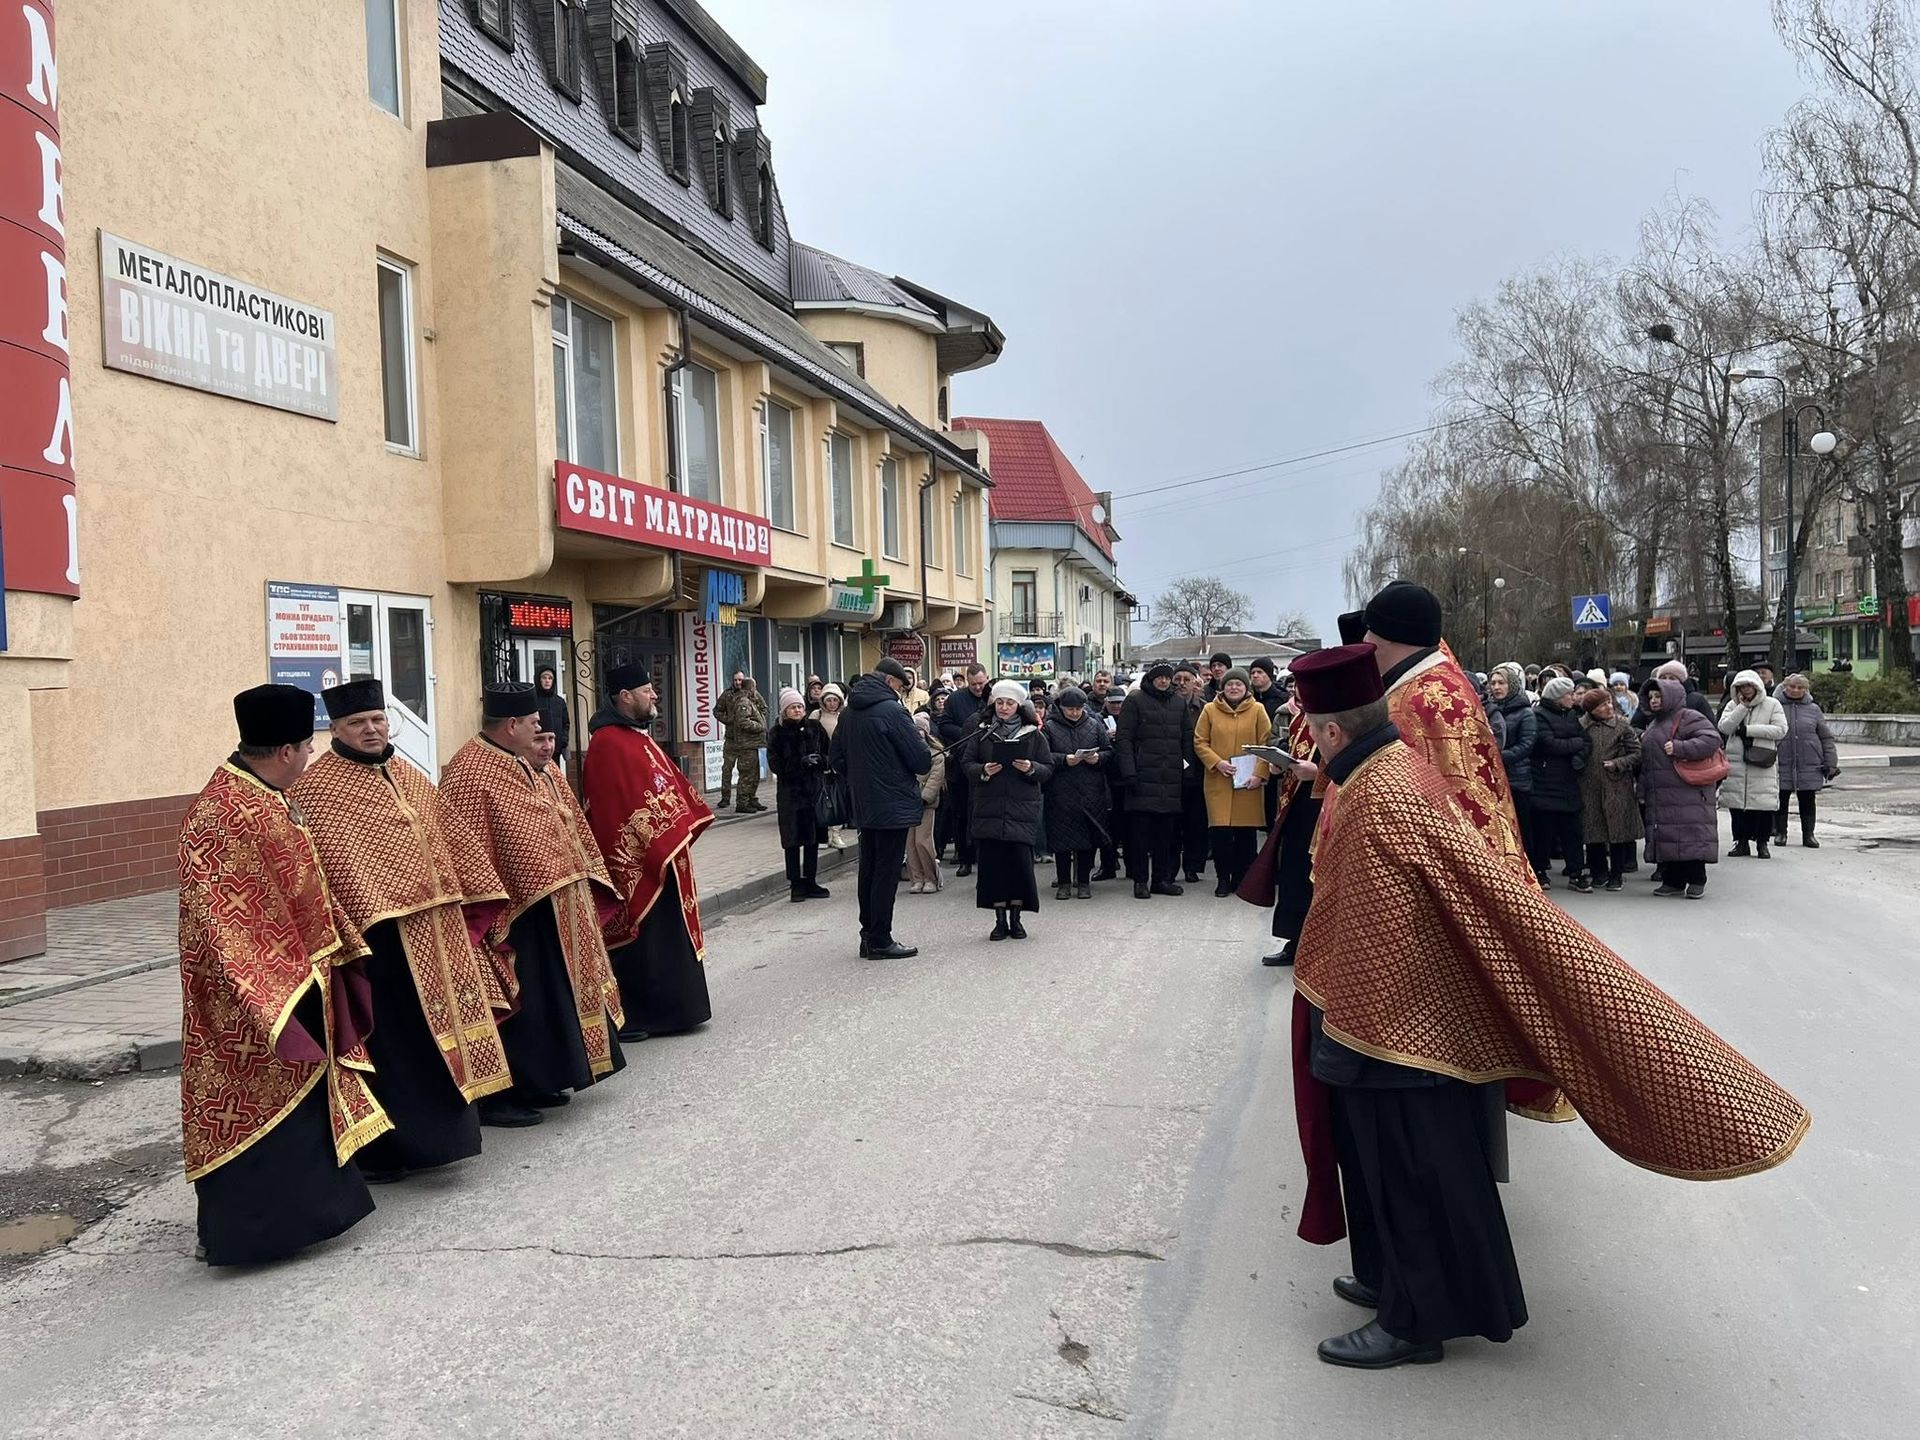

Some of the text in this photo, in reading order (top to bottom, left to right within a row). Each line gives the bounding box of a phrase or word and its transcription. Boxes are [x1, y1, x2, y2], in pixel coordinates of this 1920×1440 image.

[118, 247, 325, 341] МЕТАЛОПЛАСТИКОВІ
[120, 288, 328, 397] ВІКНА та ДВЕРІ
[566, 473, 636, 527] СВІТ
[644, 495, 756, 556] МАТРАЦІВ
[299, 604, 310, 612] ТУТ
[941, 642, 974, 652] ДИТЯЧА
[324, 677, 336, 686] ТУТ
[692, 615, 711, 718] IMMERGAS
